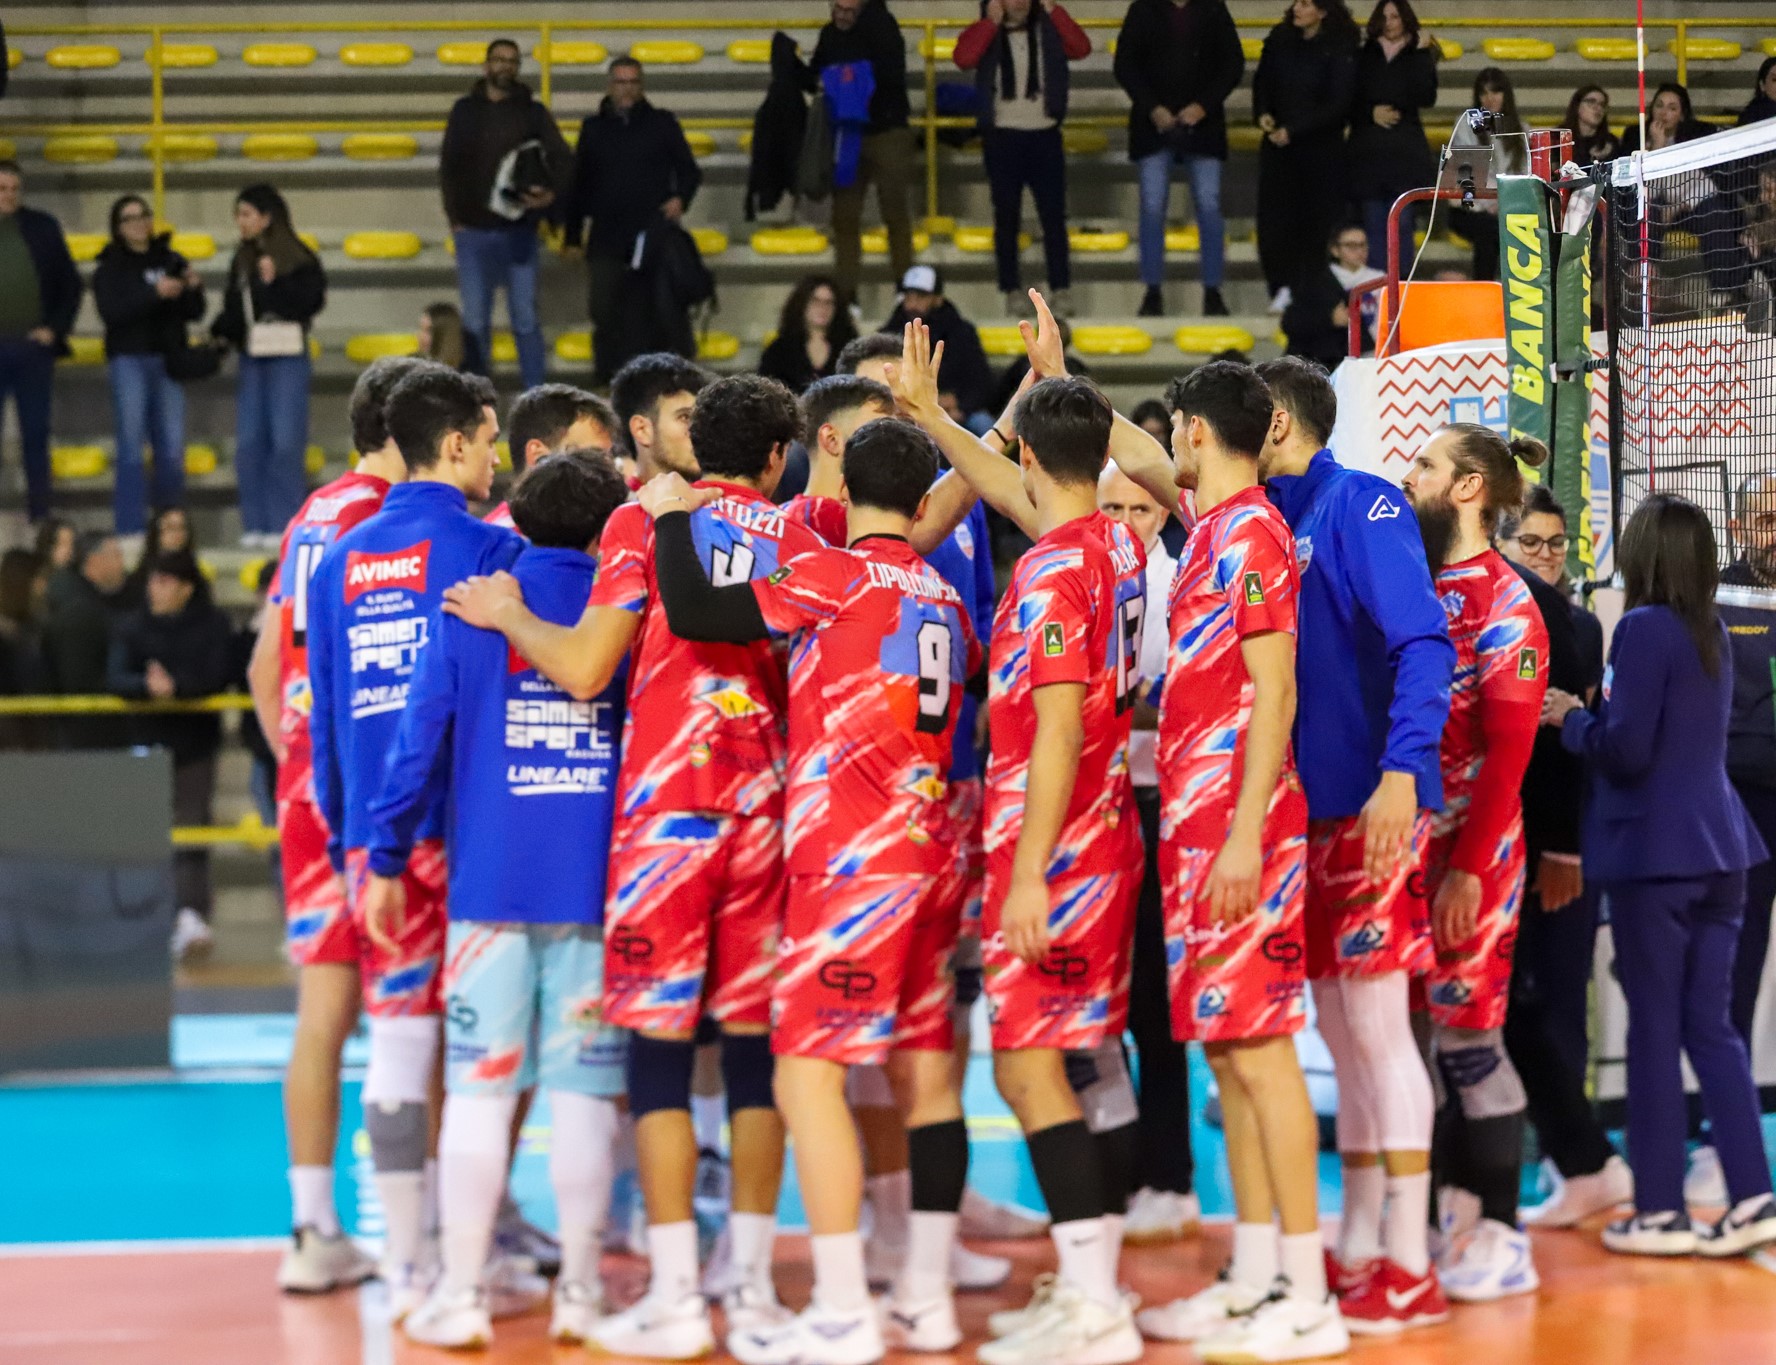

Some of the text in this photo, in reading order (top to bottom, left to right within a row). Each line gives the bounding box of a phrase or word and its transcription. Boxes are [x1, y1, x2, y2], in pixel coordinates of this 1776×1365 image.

[1507, 213, 1544, 405] BANCA
[348, 555, 422, 586] AVIMEC
[917, 621, 952, 727] 9
[507, 764, 603, 785] LINEARE
